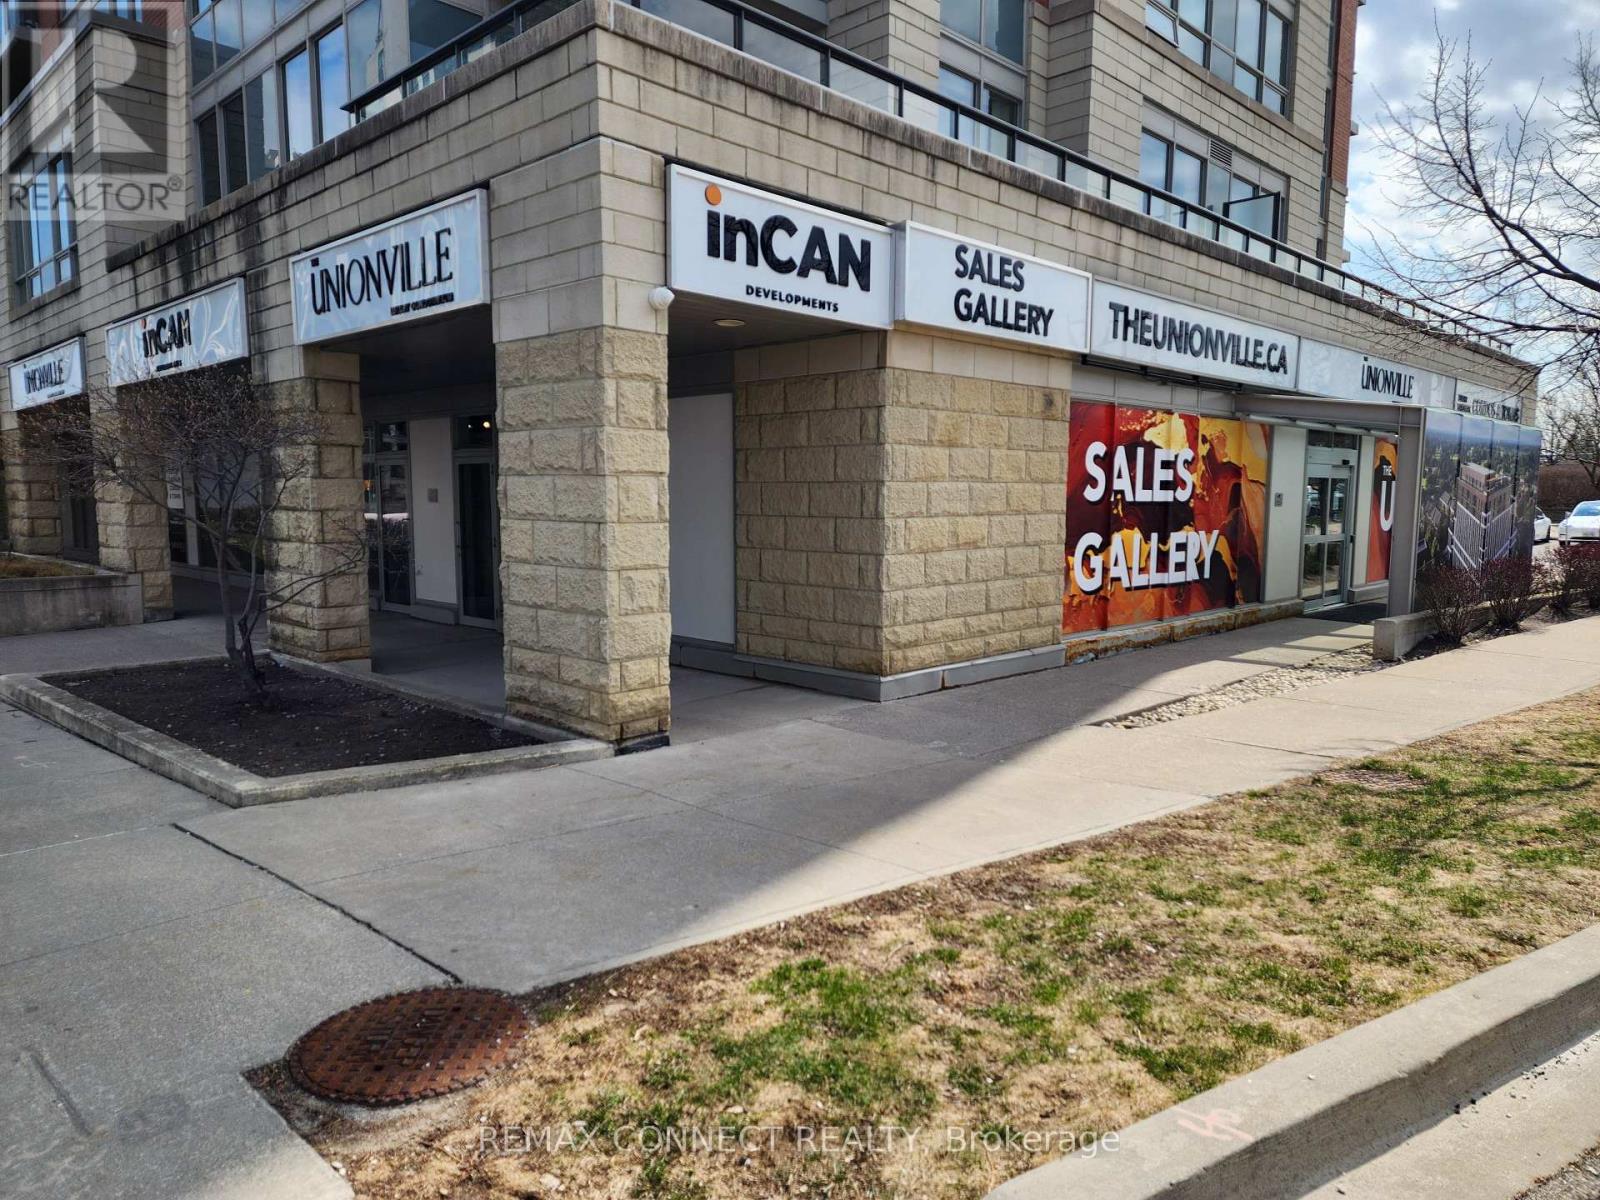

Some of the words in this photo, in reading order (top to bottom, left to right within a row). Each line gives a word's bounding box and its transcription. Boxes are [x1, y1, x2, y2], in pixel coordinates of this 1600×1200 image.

[705, 183, 871, 292] inCAN
[310, 227, 453, 316] UNIONVILLE
[954, 243, 1025, 293] SALES
[745, 284, 839, 313] DEVELOPMENTS
[953, 287, 1054, 338] GALLERY
[1108, 301, 1288, 375] THEUNIONVILLE.CA
[1361, 363, 1414, 399] UNIONVILLE
[1083, 441, 1195, 502] SALES
[1383, 465, 1392, 476] THE
[1073, 530, 1219, 592] GALLERY
